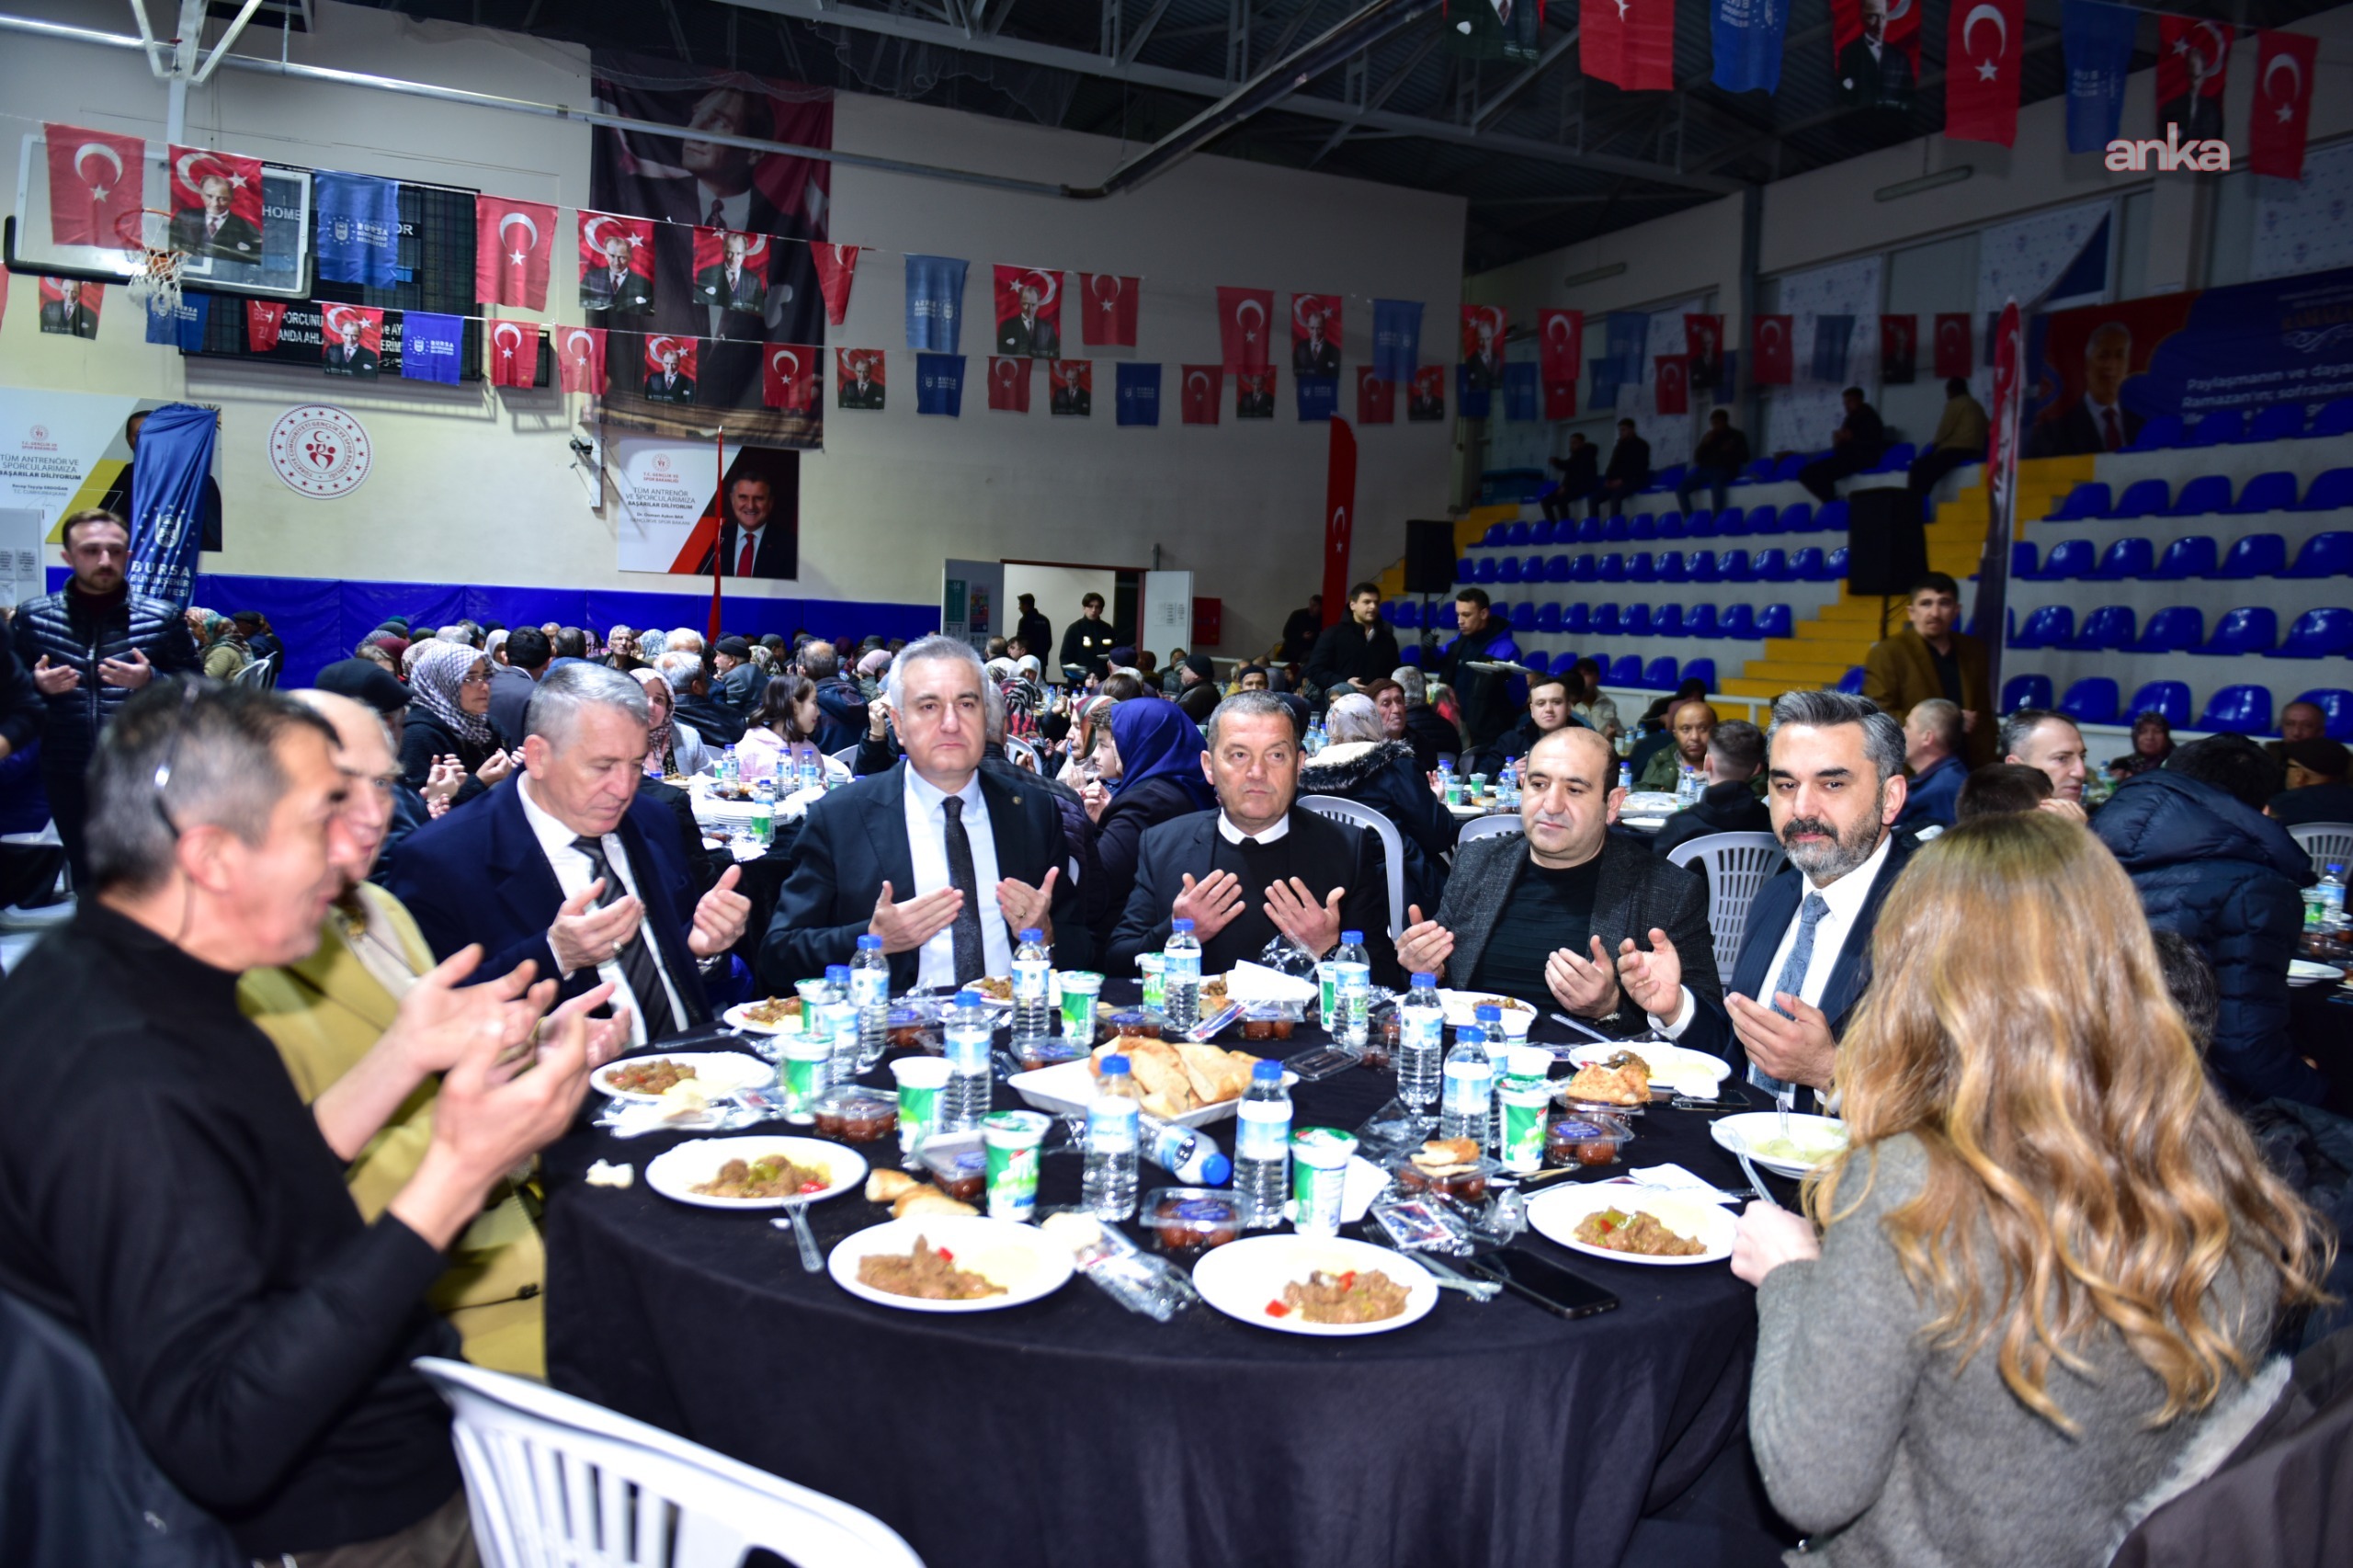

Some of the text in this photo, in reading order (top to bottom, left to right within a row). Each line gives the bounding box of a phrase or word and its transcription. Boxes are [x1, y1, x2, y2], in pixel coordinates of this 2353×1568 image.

[261, 204, 301, 221] HOME
[282, 311, 324, 327] ORCUNU
[0, 453, 19, 462] TÜM
[21, 455, 67, 465] ANTRENÖR
[2, 461, 77, 473] SPORCULARIMIZA
[0, 470, 82, 481] BAŞARILAR DİLİYORUM
[633, 486, 688, 497] TÜM ANTRENÖR
[635, 494, 696, 505] SPORCULARIMIZA
[131, 560, 190, 578] BURSA
